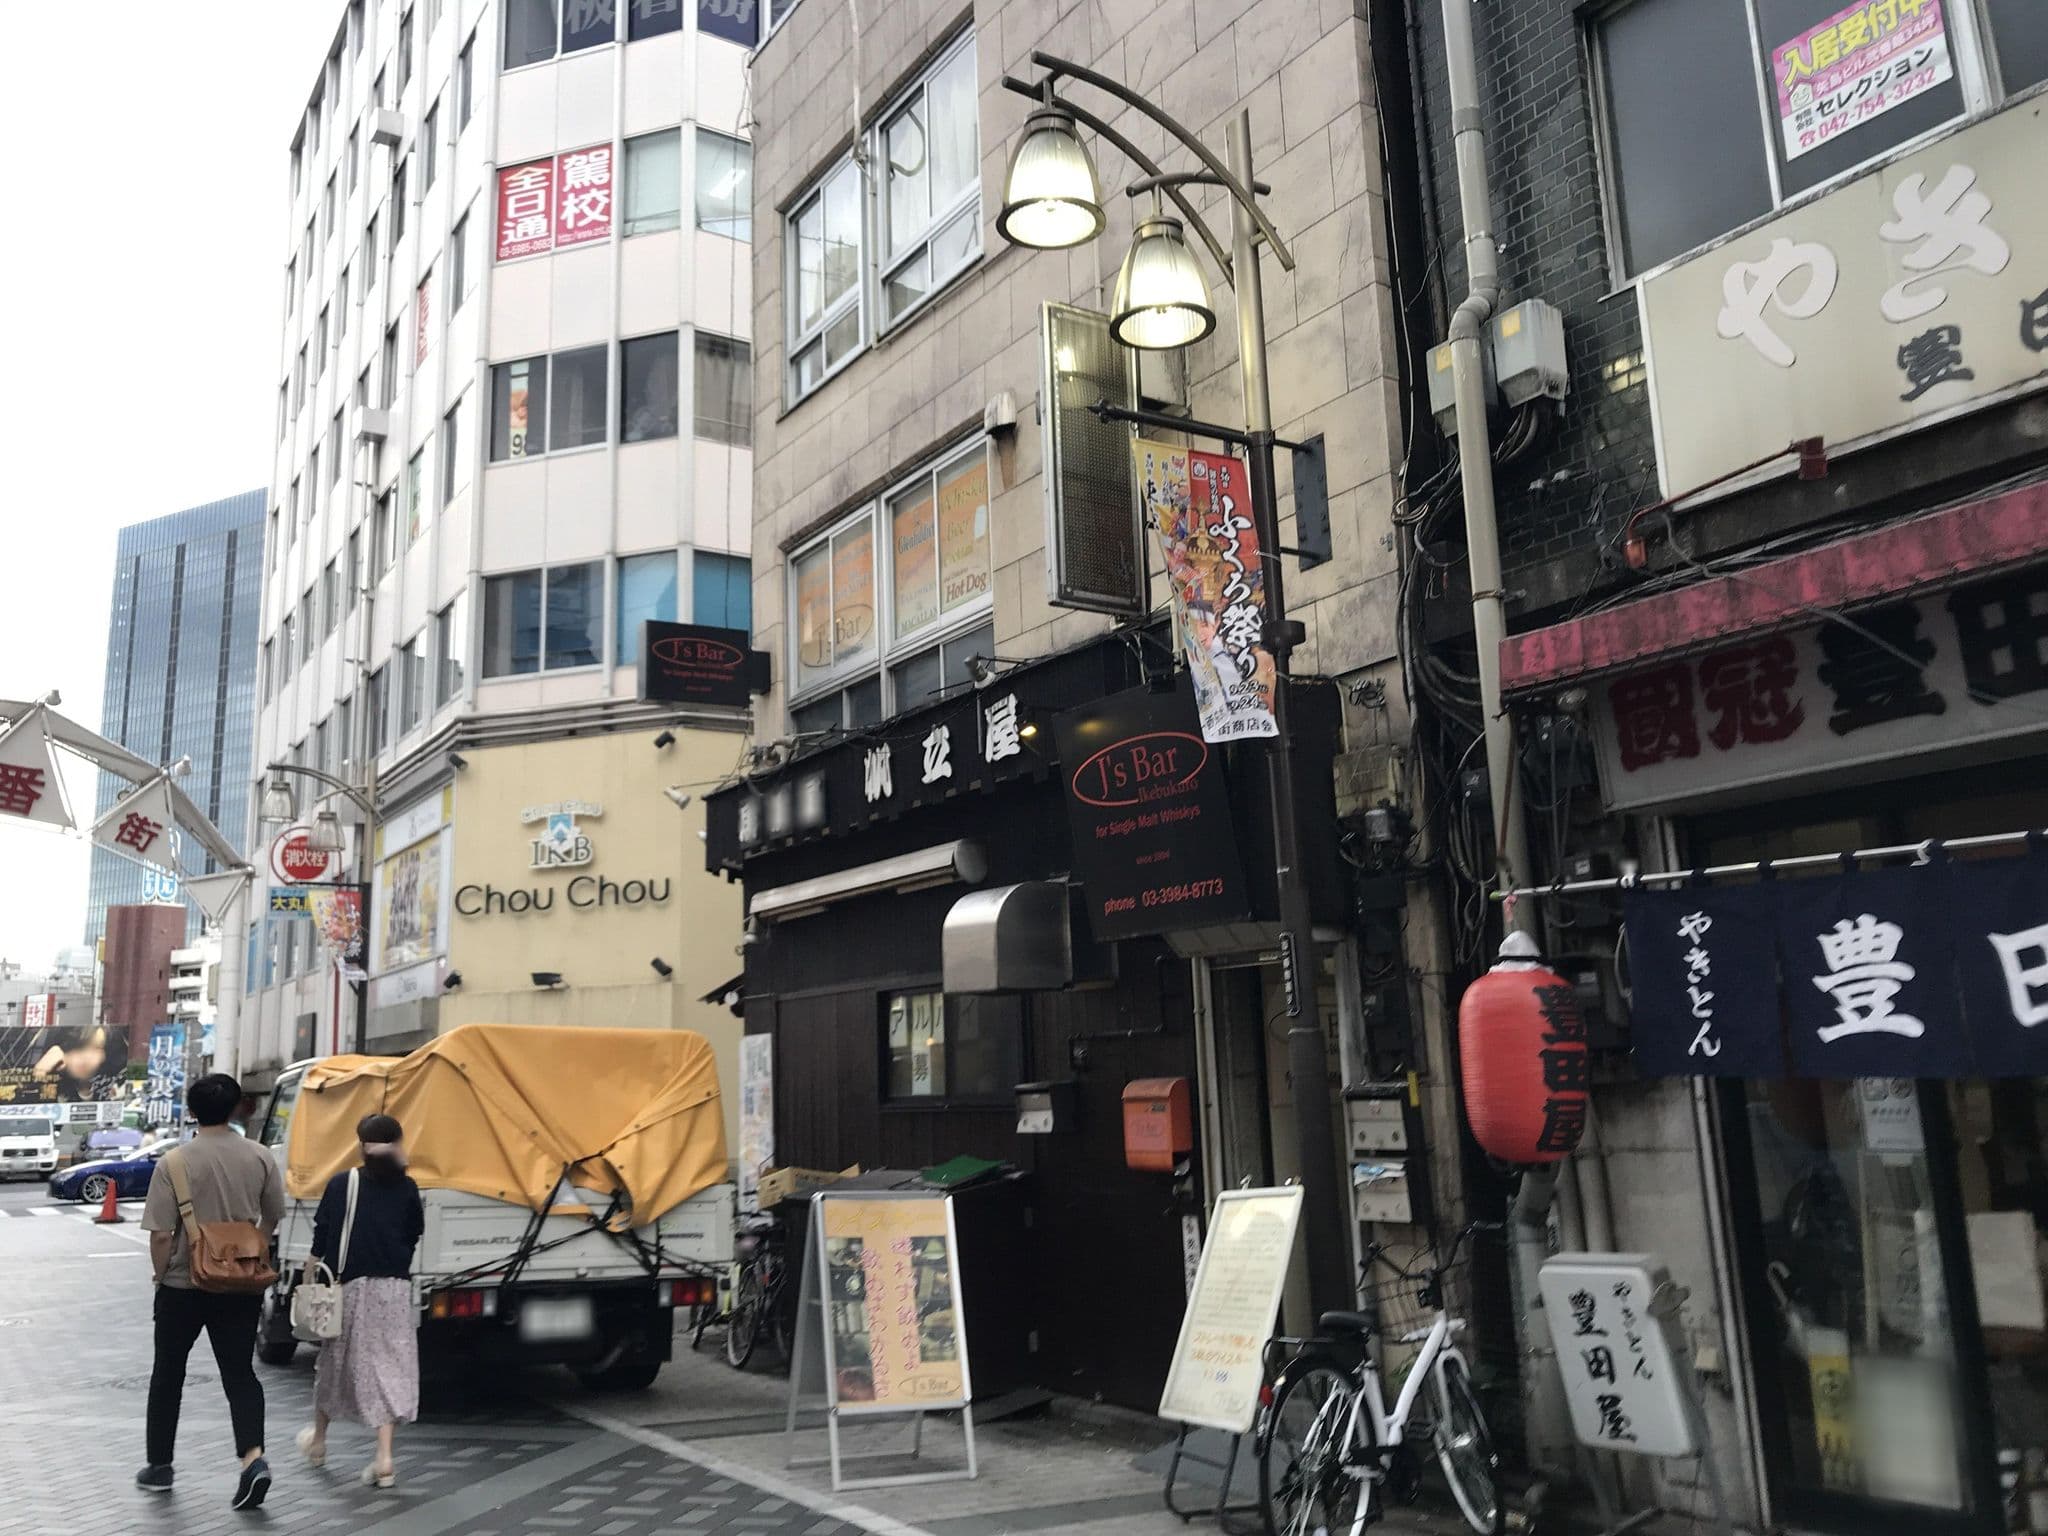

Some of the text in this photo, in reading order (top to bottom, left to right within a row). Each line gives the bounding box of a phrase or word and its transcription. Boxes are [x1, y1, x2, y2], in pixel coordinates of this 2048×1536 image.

[1816, 47, 1934, 118] セレクション
[1818, 68, 1936, 139] 042-754-3232
[502, 166, 552, 246] 全日通
[1716, 163, 2011, 368] やき
[946, 576, 966, 603] Hot
[966, 571, 987, 596] Dog
[1209, 495, 1264, 678] ふくろ祭り
[672, 640, 727, 660] J's Bar
[836, 615, 862, 645] Bar
[0, 763, 163, 853] 番 街
[1096, 745, 1177, 800] J's Bar
[286, 849, 326, 867] 消火栓
[1096, 825, 1109, 839] for
[1110, 820, 1136, 837] Single
[1138, 813, 1159, 827] Malt
[455, 875, 671, 915] Chou Chou
[1104, 878, 1224, 916] phone 03-3984-8773
[1677, 911, 1721, 1058] やきとん
[1532, 984, 1588, 1153] 豊田屋
[1567, 1287, 1638, 1444] 豊田屋
[1612, 1280, 1654, 1380] やきとん
